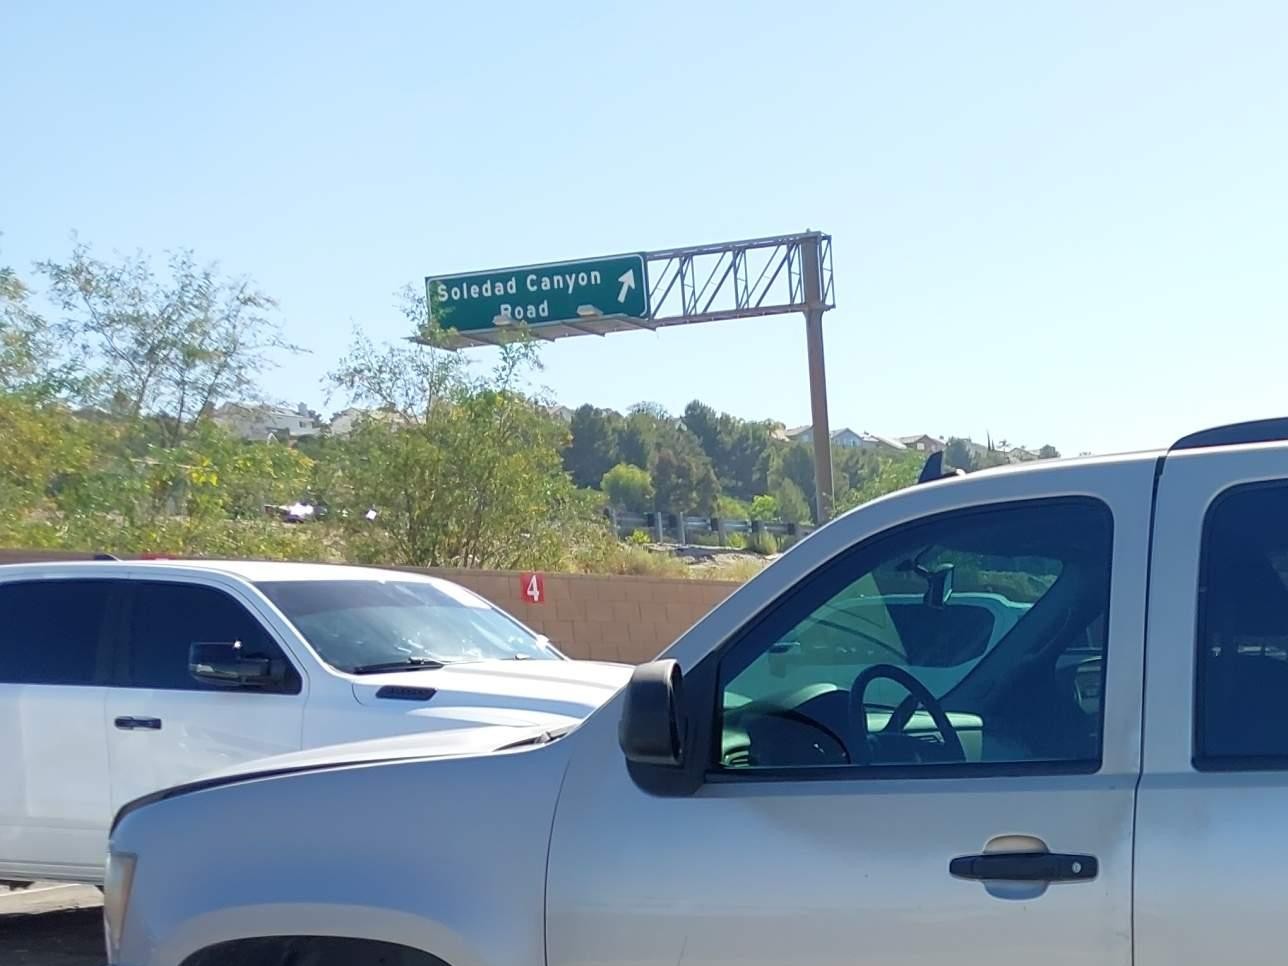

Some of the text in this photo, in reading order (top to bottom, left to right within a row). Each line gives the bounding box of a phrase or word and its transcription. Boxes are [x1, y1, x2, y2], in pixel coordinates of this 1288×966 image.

[437, 270, 601, 301] Soledad Canyon
[500, 299, 549, 319] Road
[526, 574, 540, 602] 4
